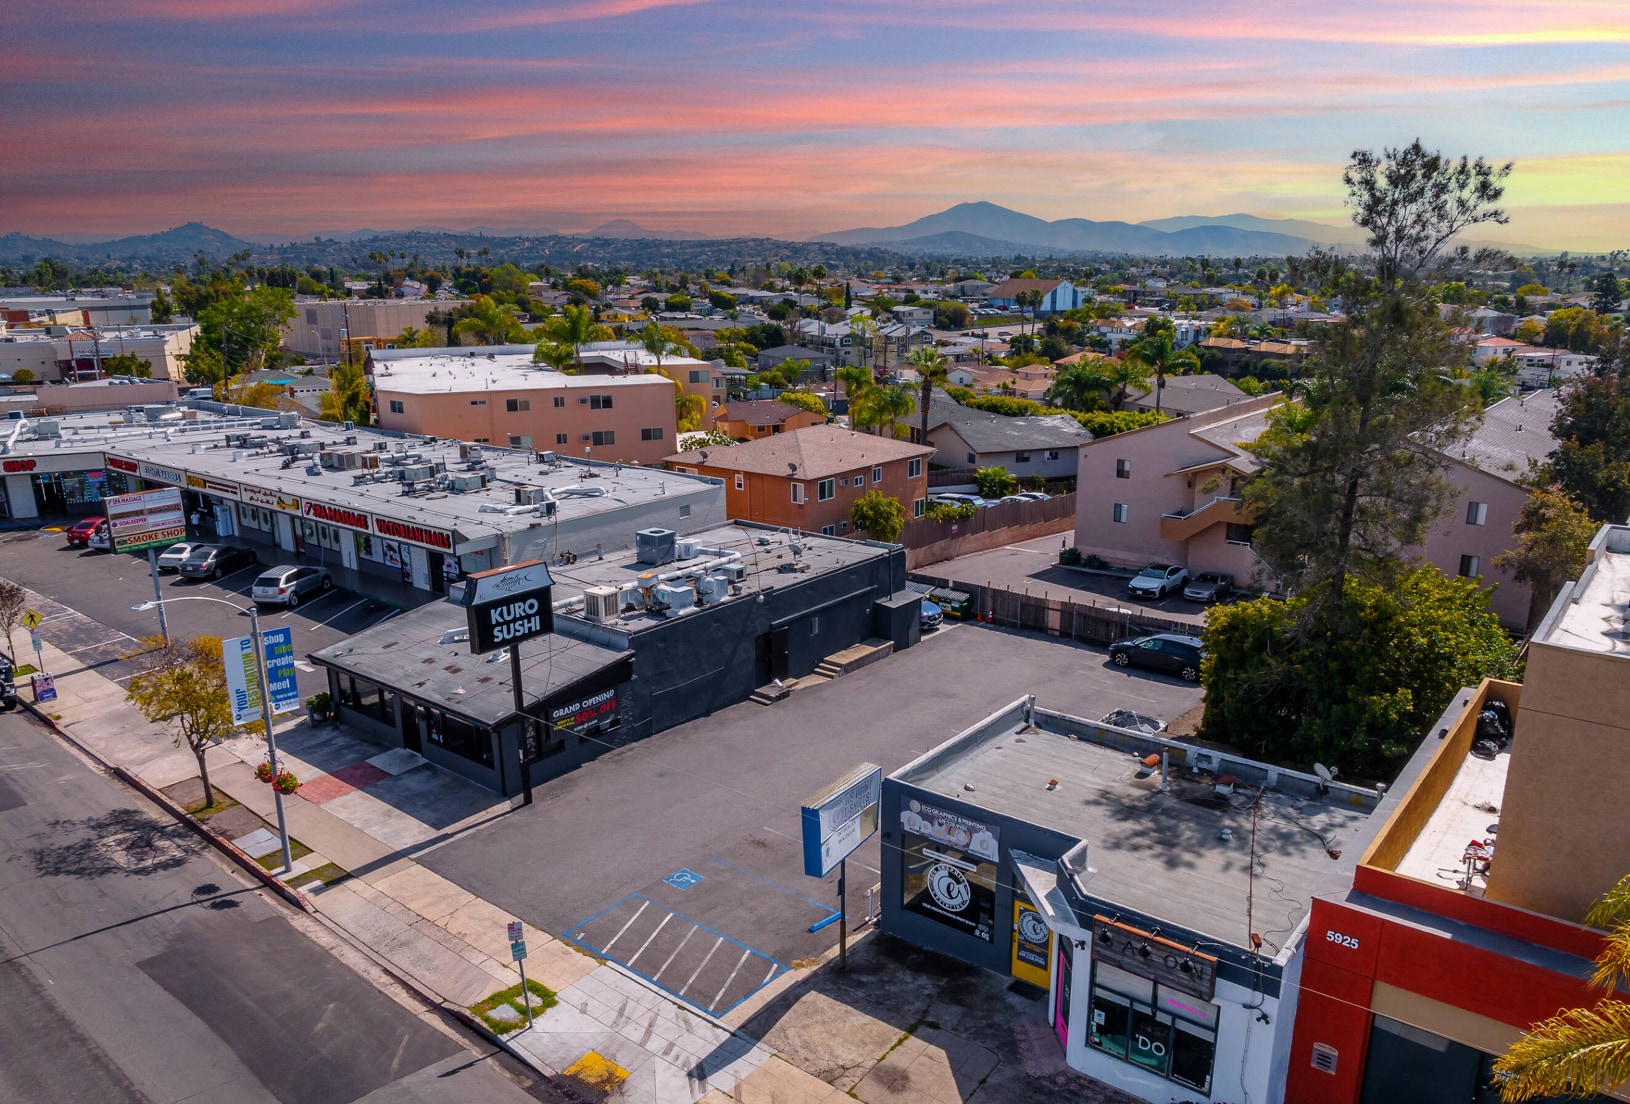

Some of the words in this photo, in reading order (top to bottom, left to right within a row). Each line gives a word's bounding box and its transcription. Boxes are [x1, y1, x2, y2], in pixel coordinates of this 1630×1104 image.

[3, 459, 36, 472] SHOP
[121, 495, 142, 504] MASSAGE
[119, 517, 147, 527] GOALKEEPER
[311, 503, 328, 519] SPA
[327, 507, 369, 530] MASSAGE
[127, 532, 160, 545] SMOKE
[161, 528, 185, 538] SHOP
[375, 518, 423, 543] VICTORIAN
[423, 528, 452, 549] NAILS
[490, 598, 539, 625] KURO
[493, 615, 541, 643] SUSHI
[242, 651, 260, 709] DESTINATION
[235, 688, 249, 712] YOUR
[552, 702, 581, 718] GRAND
[582, 689, 615, 708] OPENING
[575, 709, 598, 724] 50%
[599, 699, 617, 714] OFF
[931, 808, 958, 822] GRAPHICS
[962, 818, 987, 831] PRINTING
[1326, 930, 1359, 949] 5925
